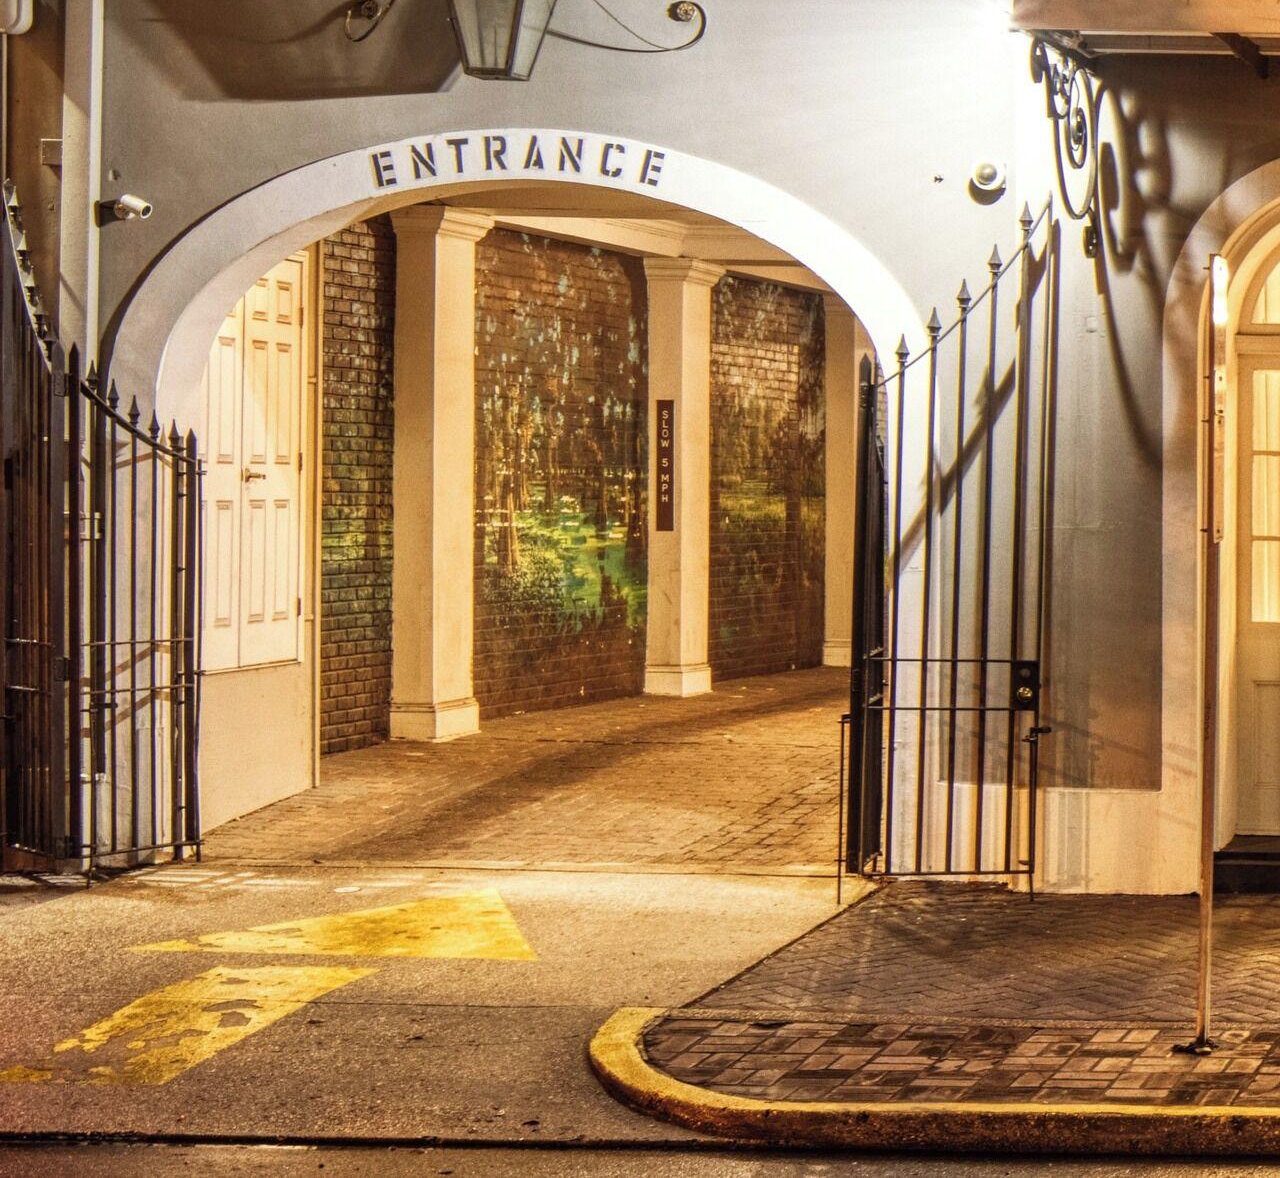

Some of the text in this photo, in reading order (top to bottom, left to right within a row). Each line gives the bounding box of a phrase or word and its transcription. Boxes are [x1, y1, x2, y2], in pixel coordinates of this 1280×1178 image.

[370, 135, 666, 188] ENTRANCE
[660, 410, 670, 503] SLOW 5 MPH
